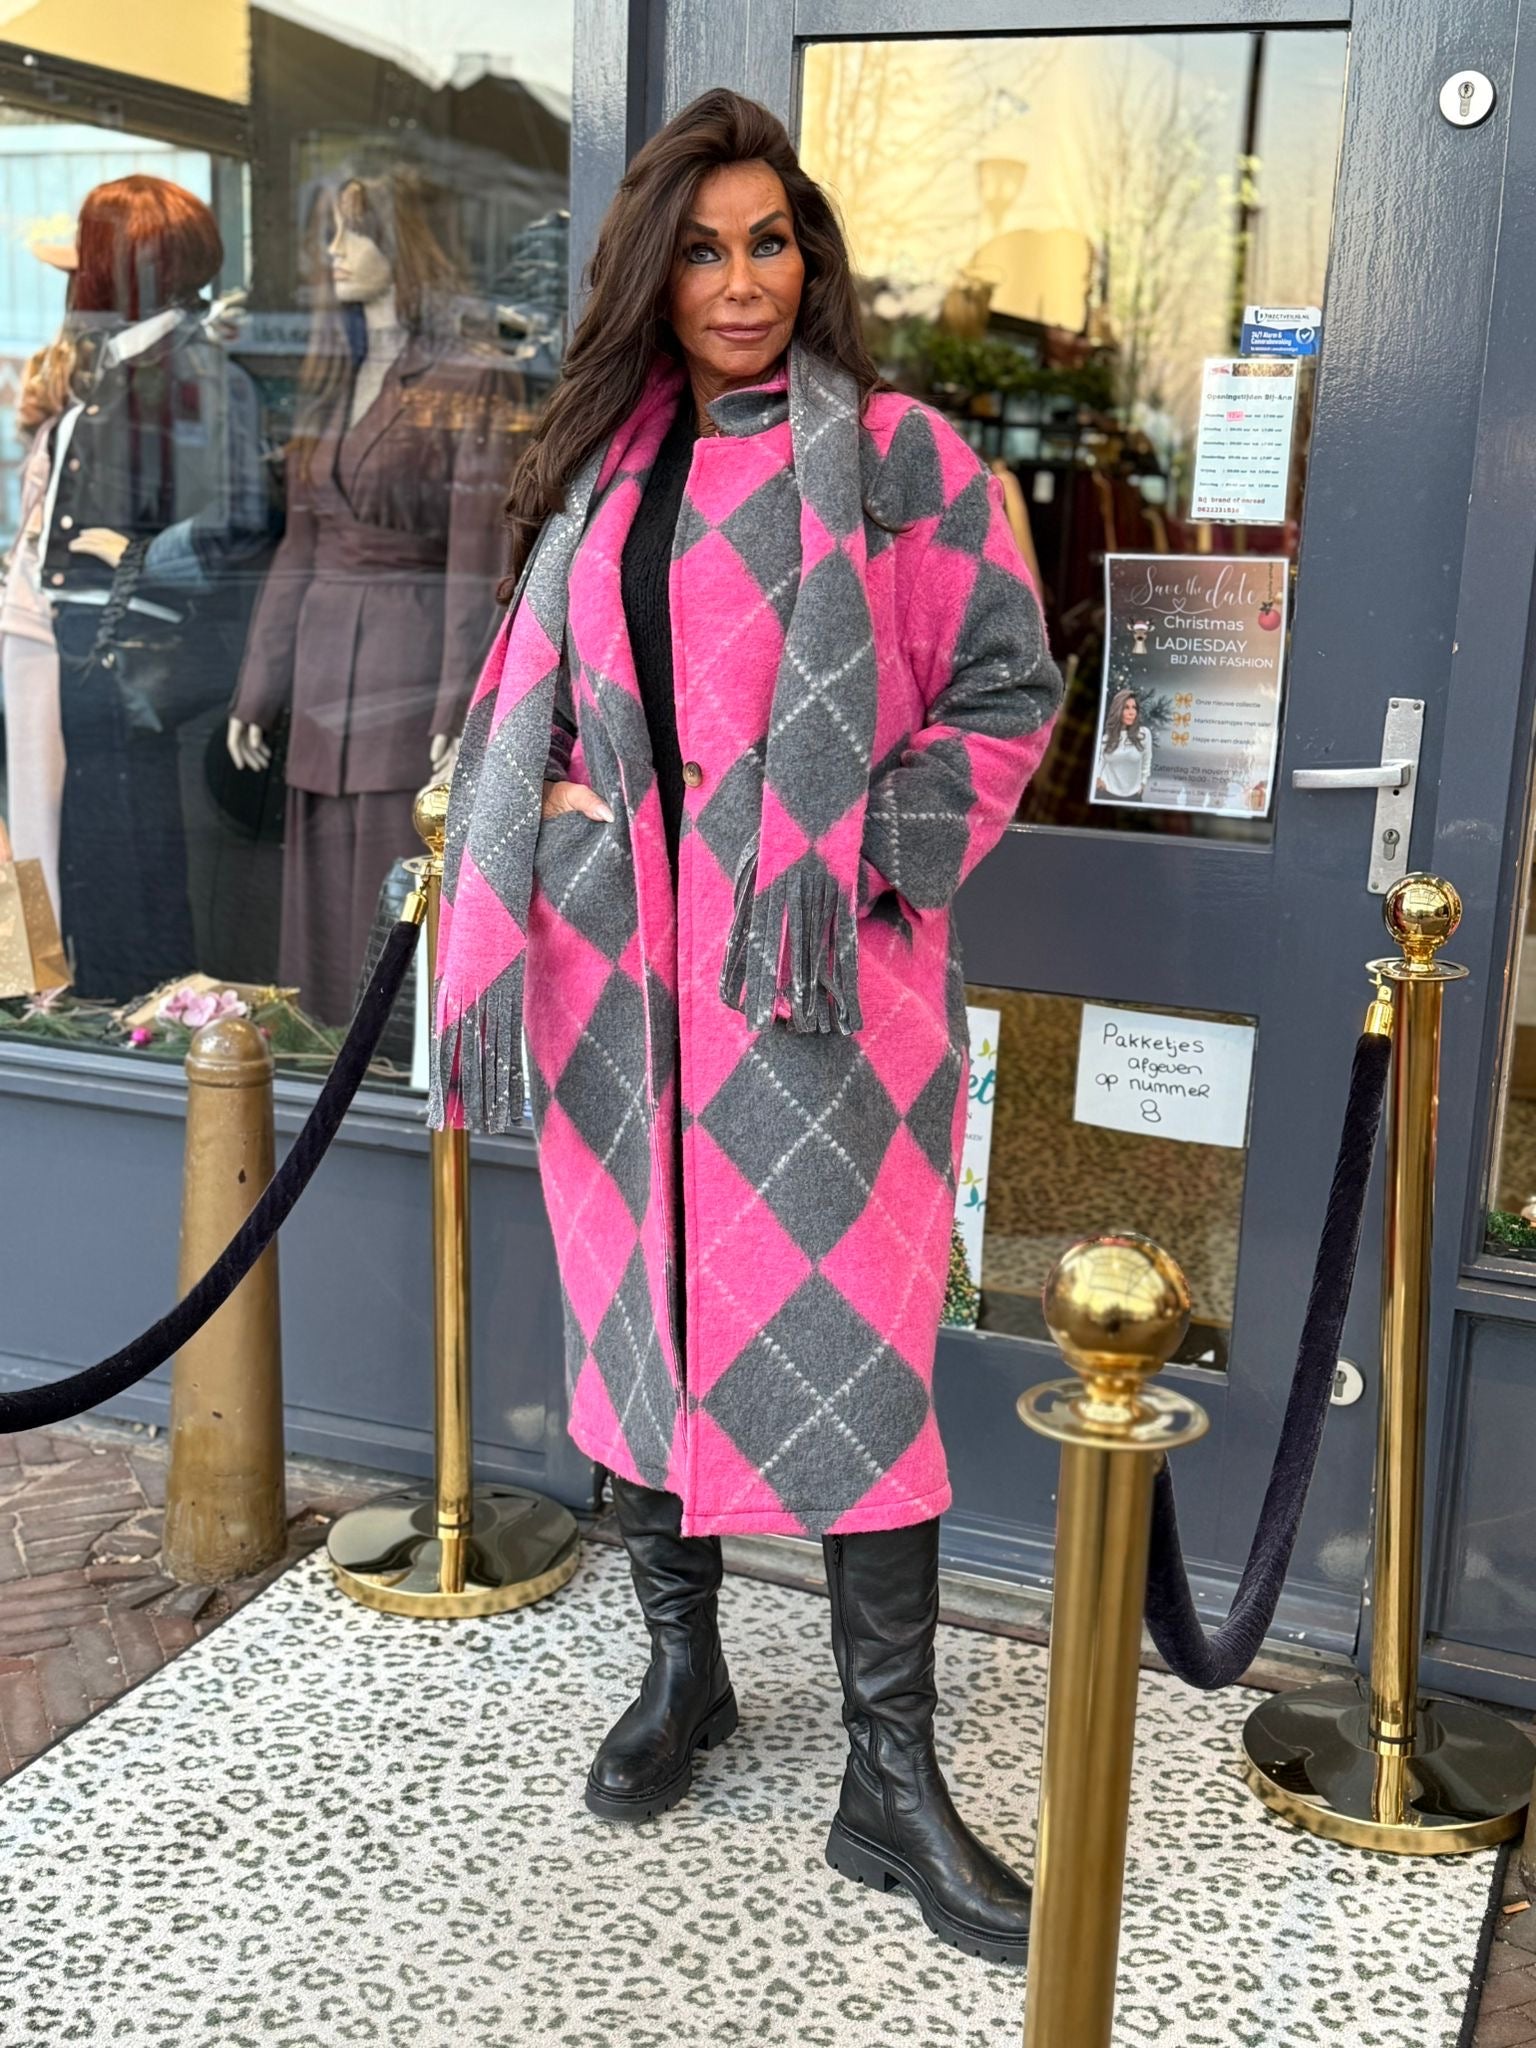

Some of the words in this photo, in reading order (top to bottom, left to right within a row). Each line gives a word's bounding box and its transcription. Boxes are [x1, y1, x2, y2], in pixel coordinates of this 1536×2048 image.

[1206, 393, 1262, 402] Openingstijden
[1210, 496, 1231, 504] brand
[1125, 564, 1184, 606] Save
[1186, 575, 1202, 596] the
[1205, 564, 1257, 609] date
[1164, 616, 1244, 632] Christmas
[1156, 636, 1248, 653] LADIESDAY
[1170, 654, 1189, 666] BIJ
[1190, 655, 1217, 667] ANN
[1219, 656, 1273, 669] FASHION
[1153, 764, 1190, 774] Zaterdag
[1190, 766, 1200, 774] 29
[1102, 1022, 1205, 1058] Pakketjes
[1128, 1056, 1202, 1078] afgeven
[1095, 1072, 1119, 1092] op
[1140, 1098, 1162, 1123] 8
